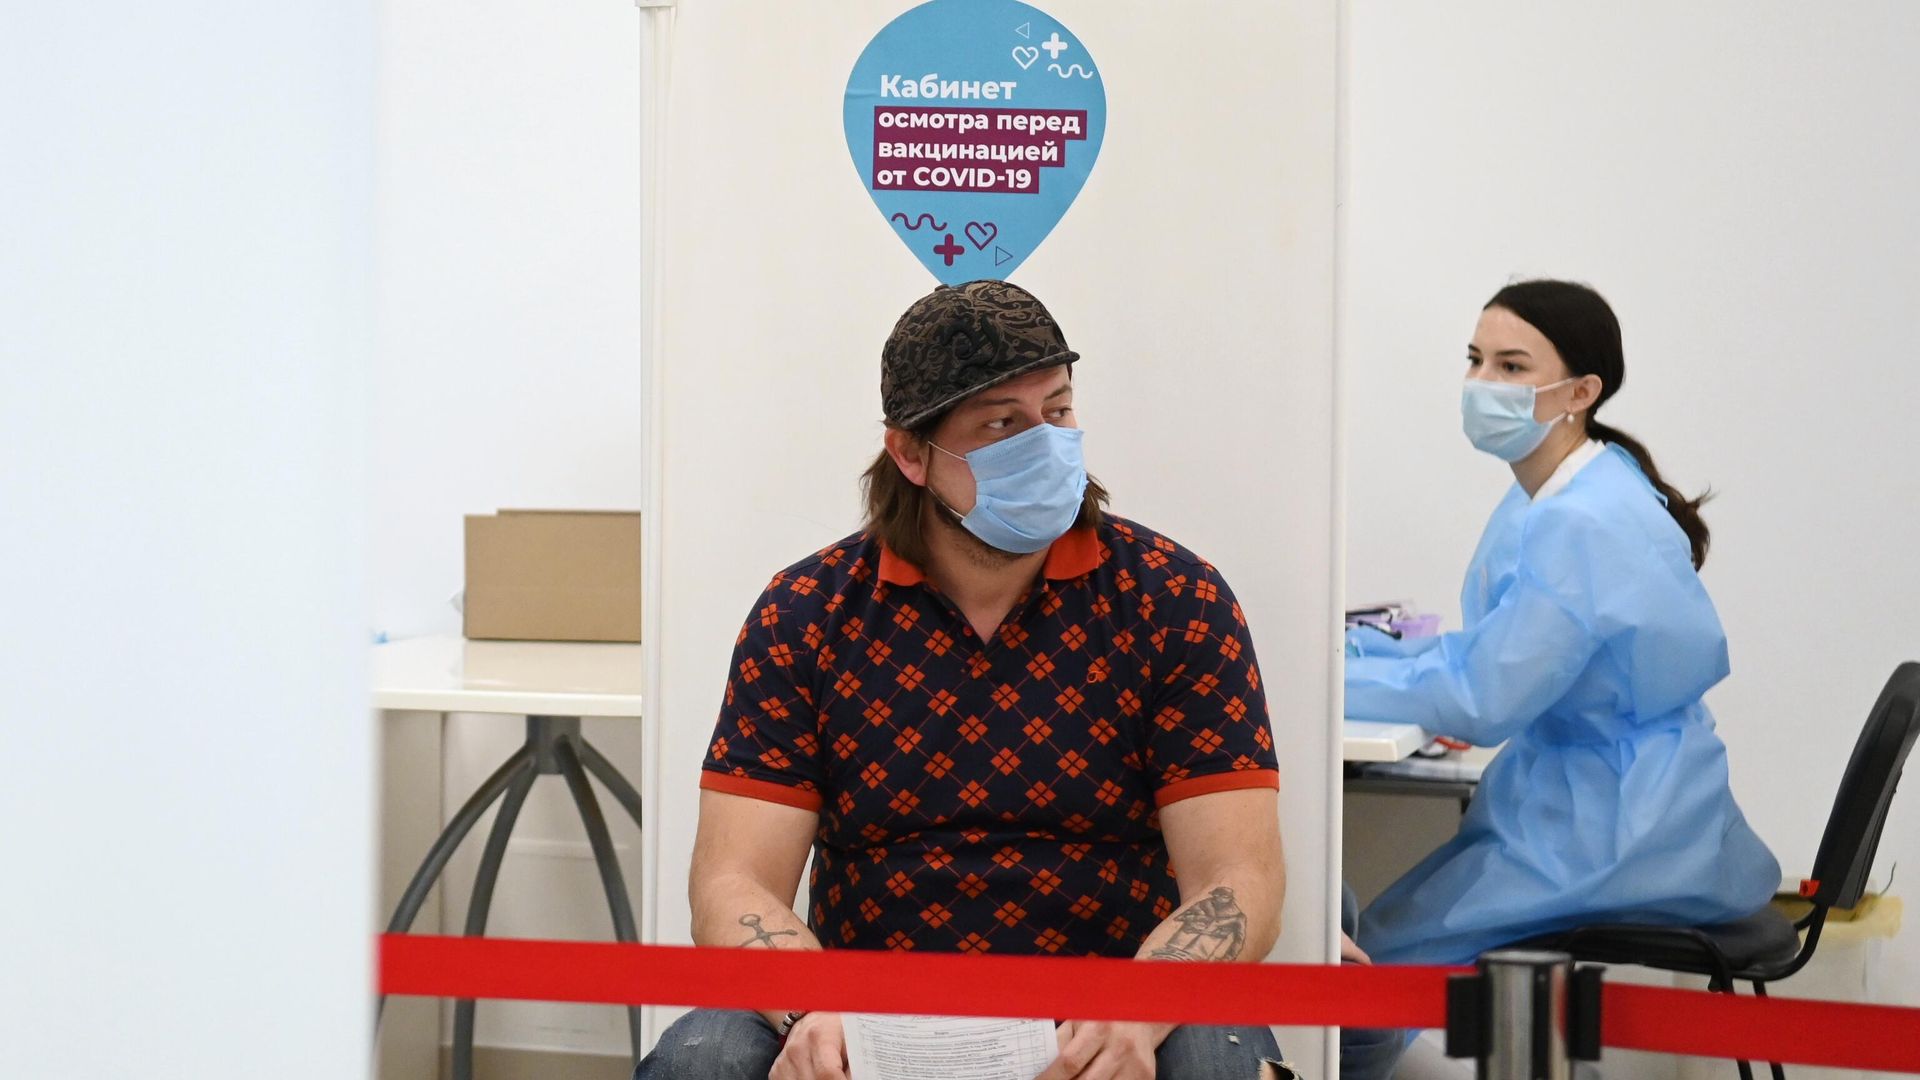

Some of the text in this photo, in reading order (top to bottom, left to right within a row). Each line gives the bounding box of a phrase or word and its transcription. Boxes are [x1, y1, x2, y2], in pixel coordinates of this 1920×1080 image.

[880, 74, 1017, 100] Кабинет
[878, 112, 1081, 135] осмотра перед
[878, 140, 1058, 162] вакцинацией
[877, 167, 1032, 189] от COVID-19
